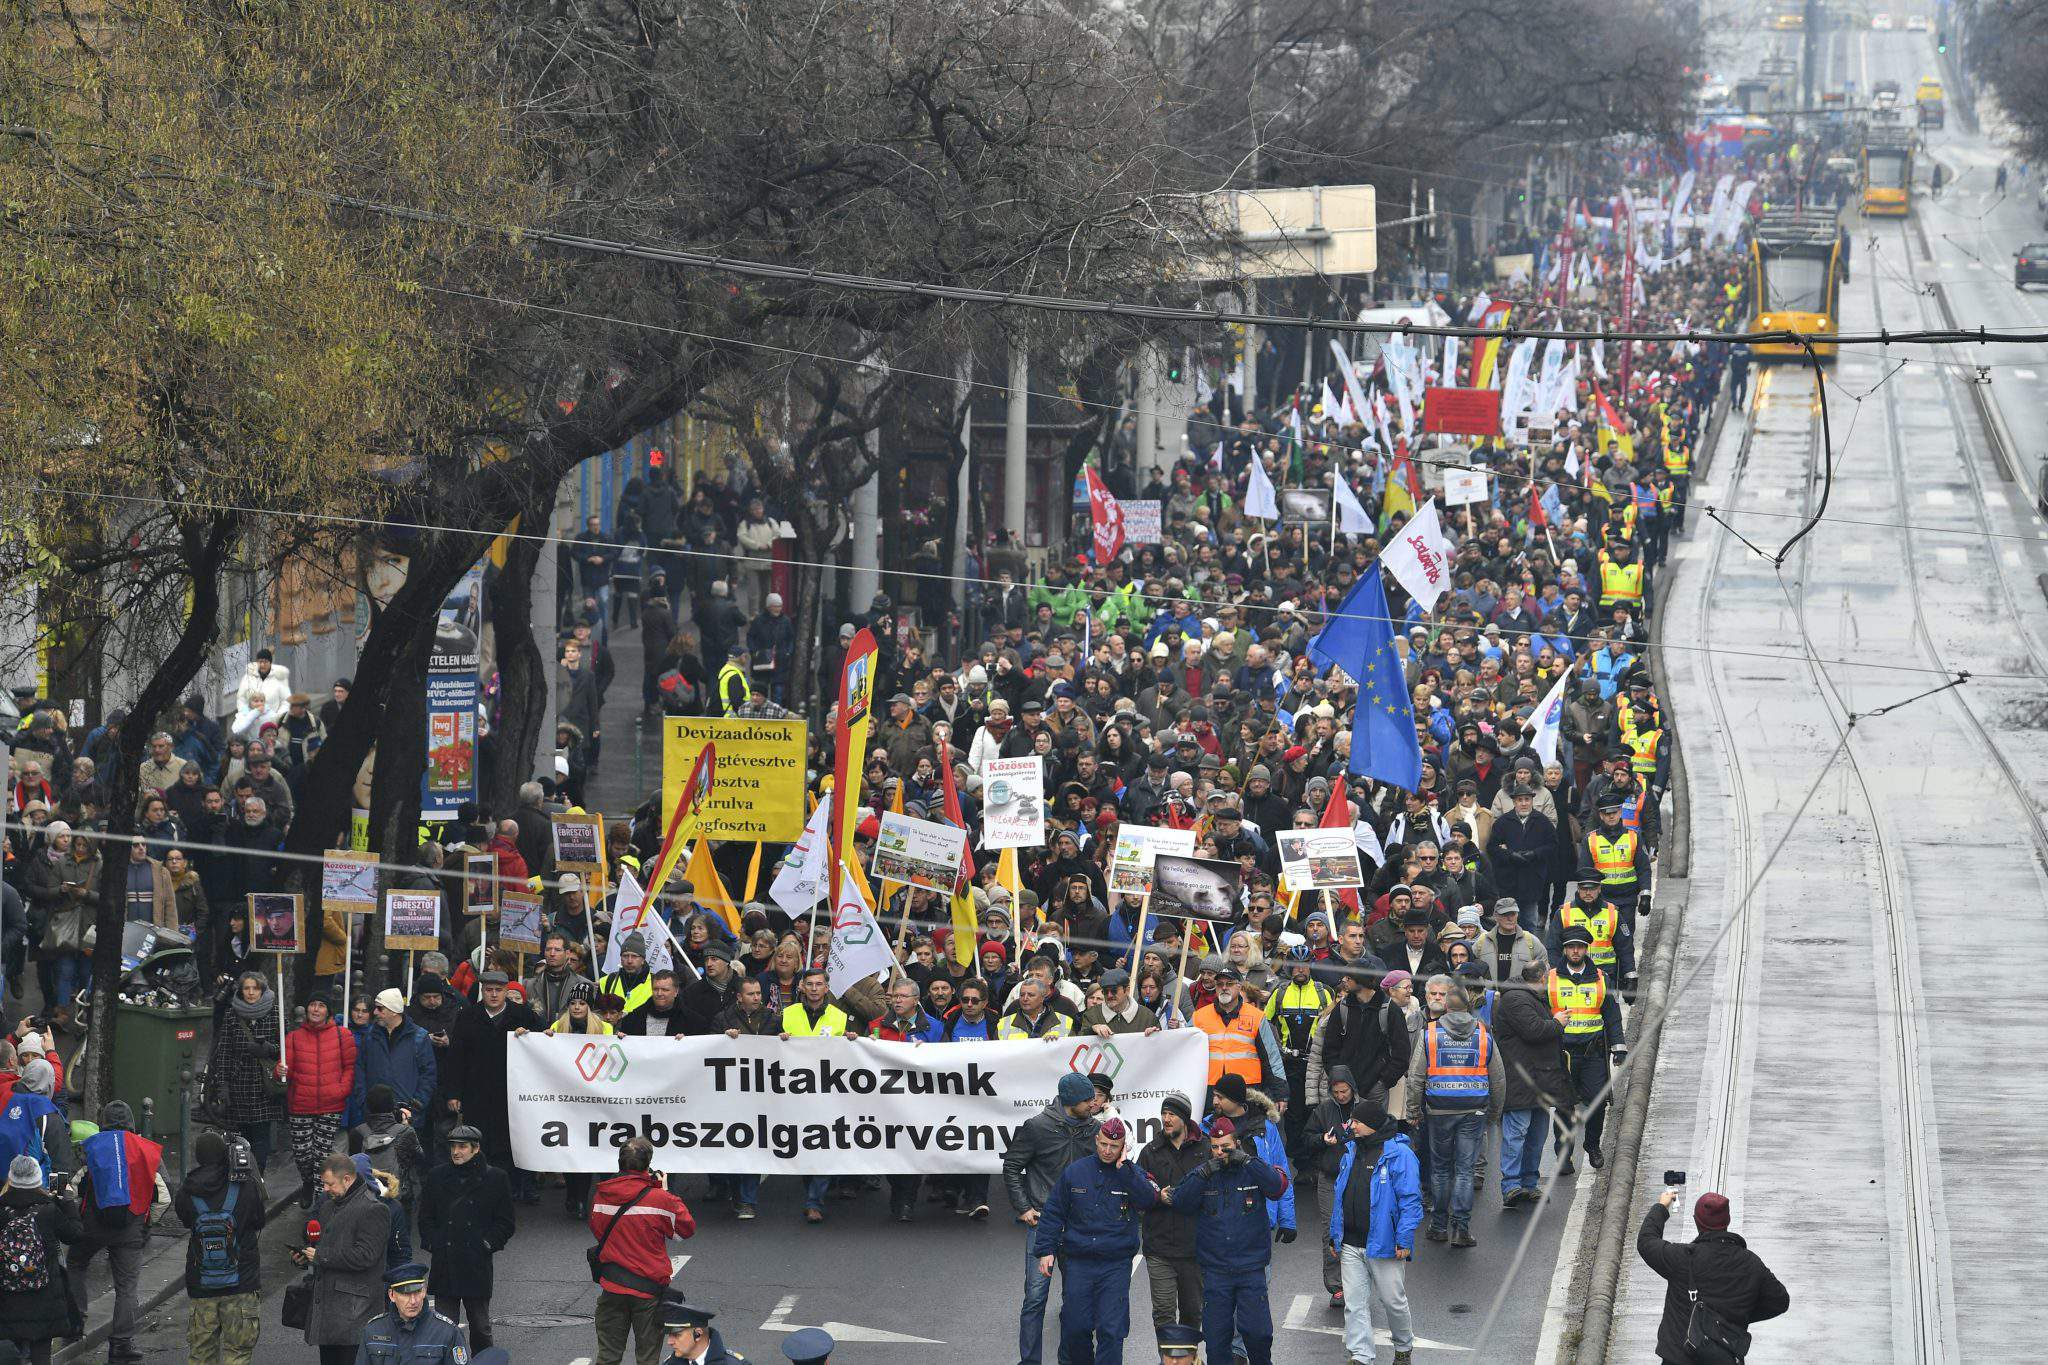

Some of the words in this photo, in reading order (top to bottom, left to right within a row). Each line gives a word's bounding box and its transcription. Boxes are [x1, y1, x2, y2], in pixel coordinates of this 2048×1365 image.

[677, 725, 793, 741] Devizaadósok
[695, 754, 796, 769] gtévesztve
[988, 760, 1036, 772] Közösen
[392, 900, 433, 909] ÉBRESZTŐ!
[704, 1057, 998, 1096] Tiltakozunk
[518, 1094, 555, 1102] MAGYAR
[558, 1095, 632, 1105] SZAKSZERVEZETI
[635, 1095, 686, 1105] SZÖVETSÉG
[541, 1120, 569, 1147] a
